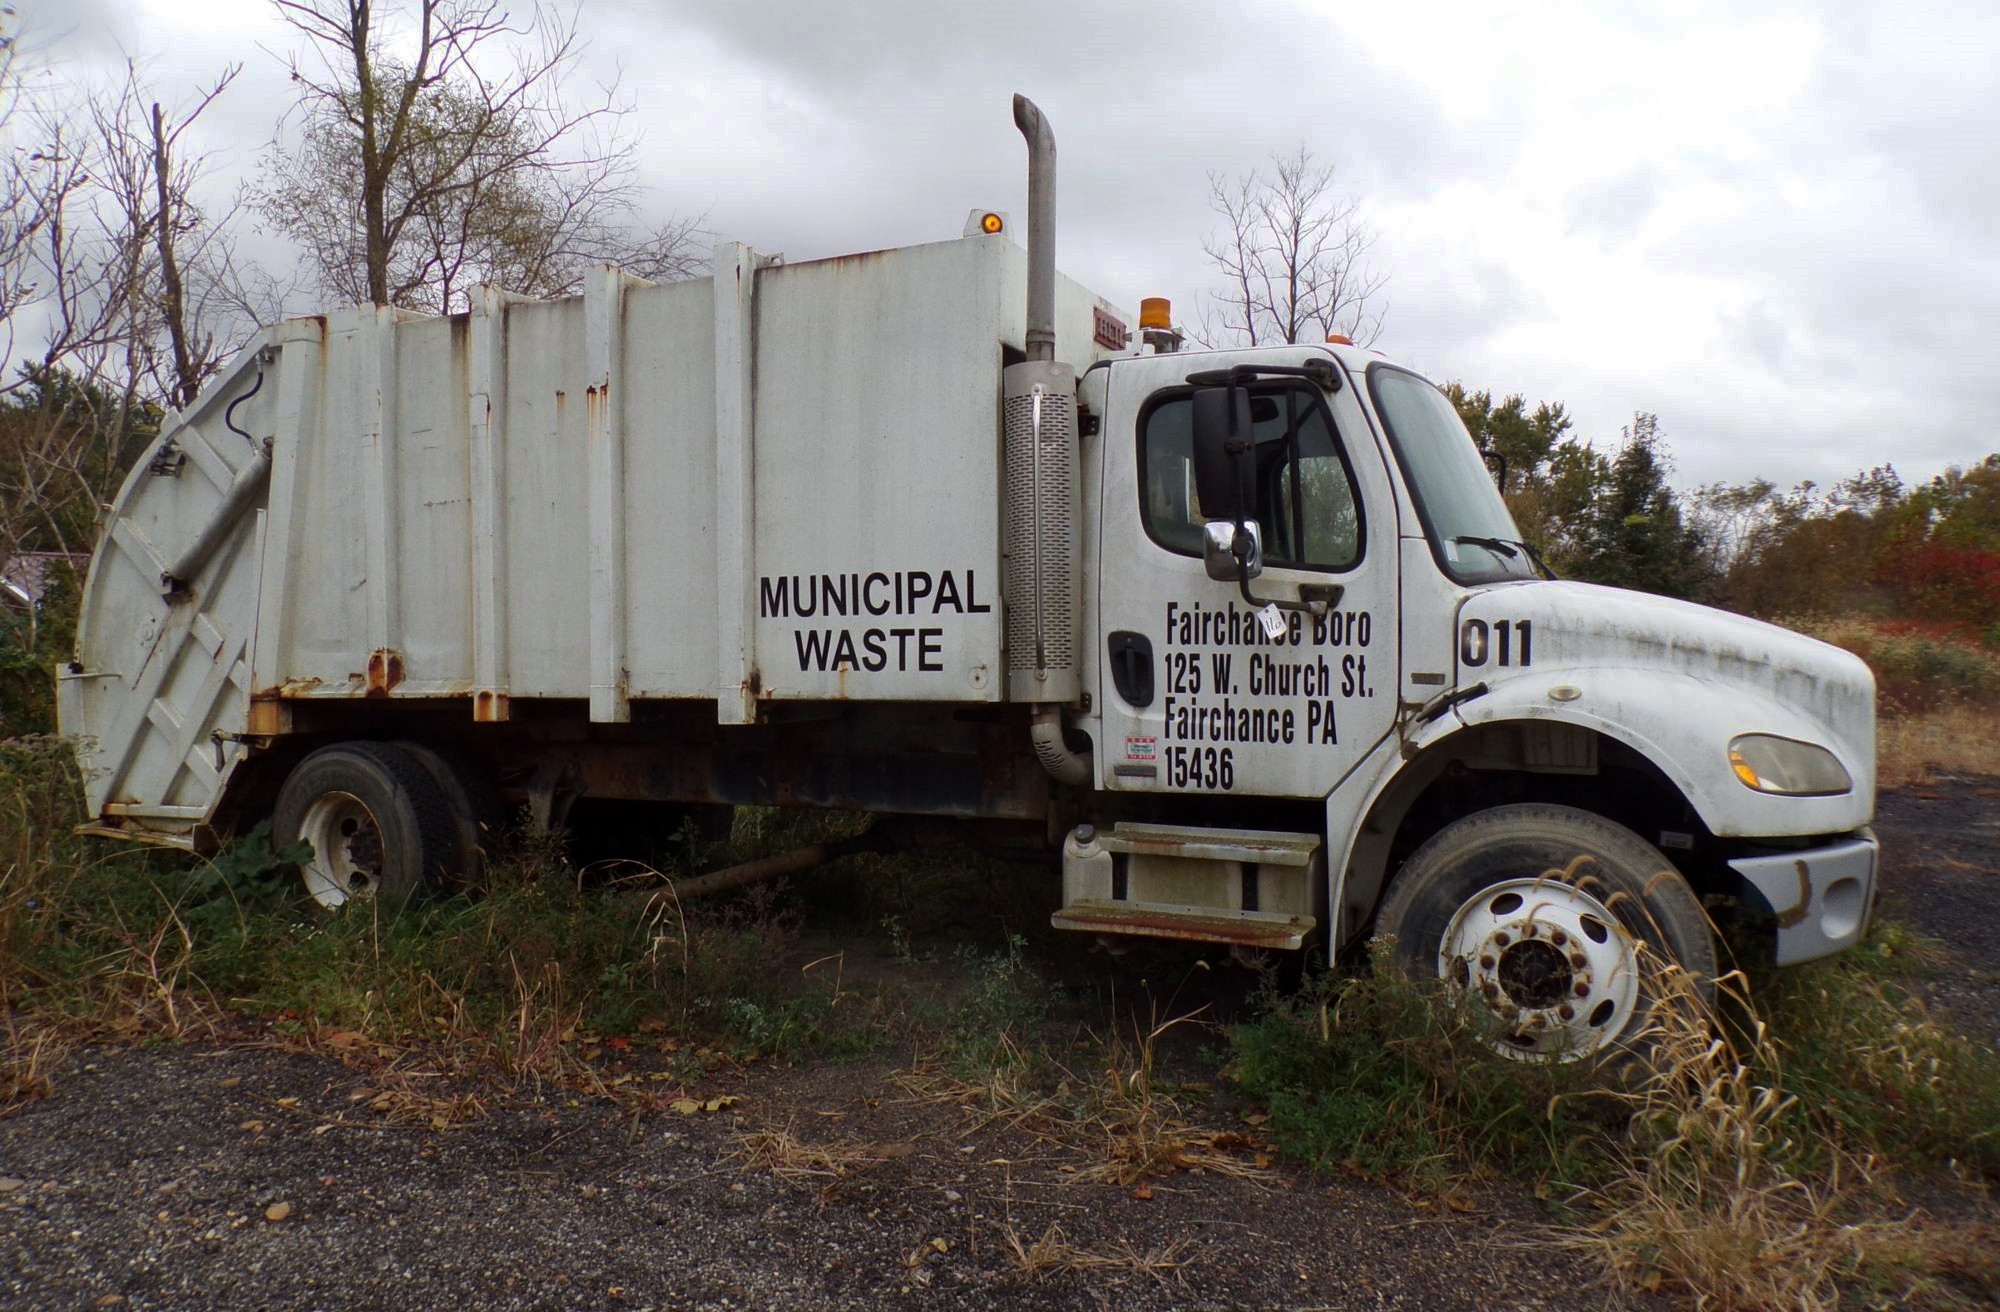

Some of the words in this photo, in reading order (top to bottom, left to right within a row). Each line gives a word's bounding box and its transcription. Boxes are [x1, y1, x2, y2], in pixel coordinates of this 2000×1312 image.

[760, 569, 991, 618] MUNICIPAL
[1312, 605, 1371, 648] Boro
[1460, 618, 1532, 667] 011
[794, 628, 943, 672] WASTE
[1165, 652, 1201, 694] 125
[1212, 653, 1238, 695] W.
[1250, 653, 1330, 696] Church
[1341, 654, 1374, 698] St.
[1164, 696, 1295, 744] Fairchance
[1308, 700, 1338, 745] PA
[1165, 746, 1234, 790] 15436
